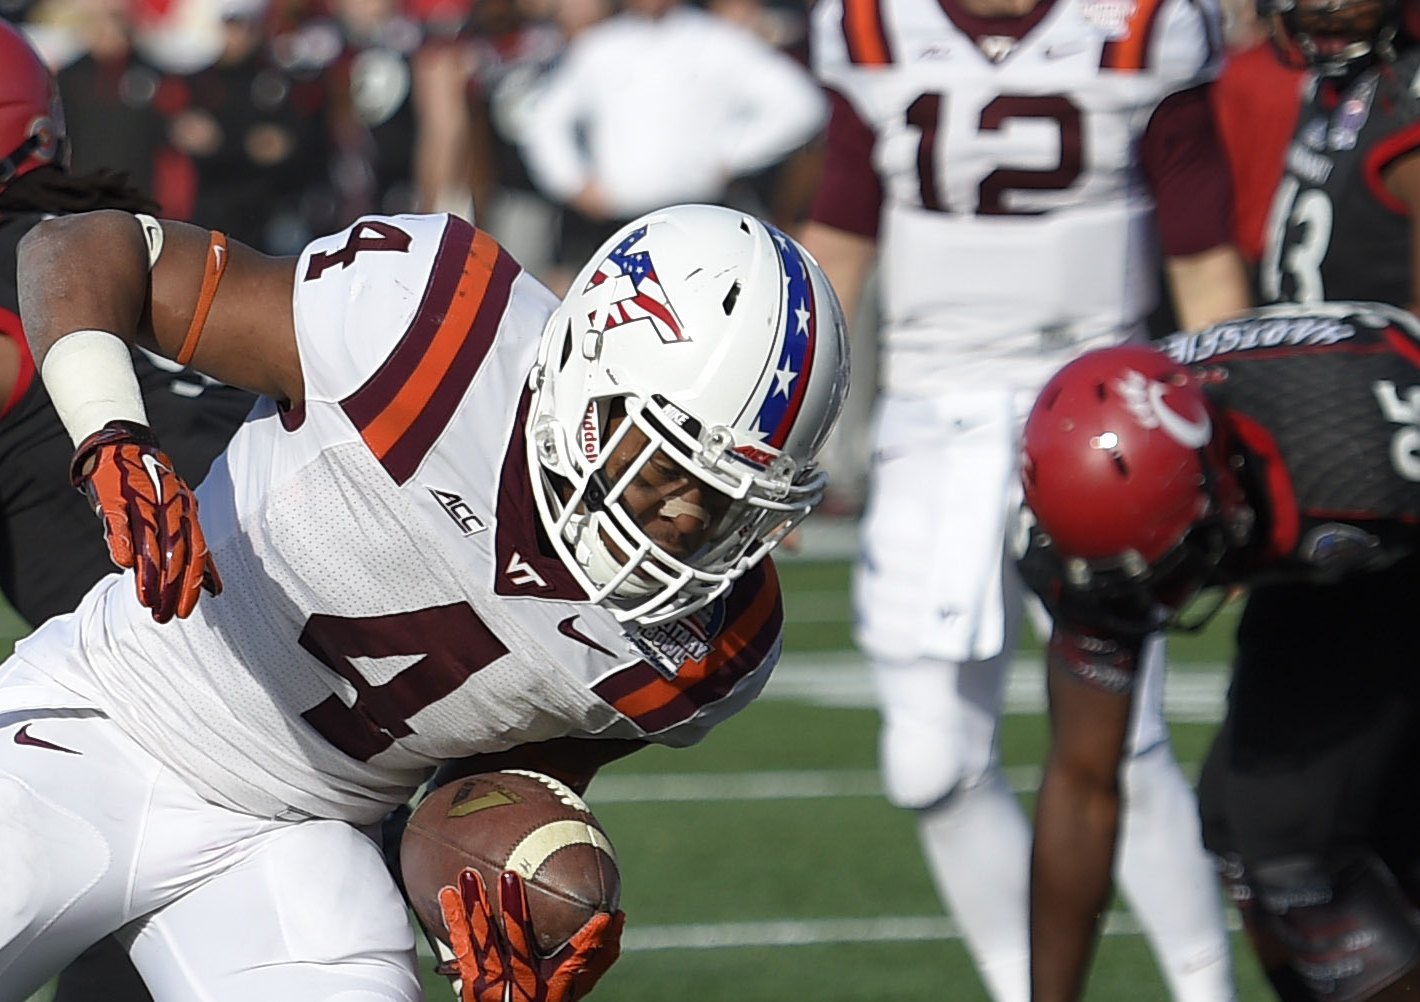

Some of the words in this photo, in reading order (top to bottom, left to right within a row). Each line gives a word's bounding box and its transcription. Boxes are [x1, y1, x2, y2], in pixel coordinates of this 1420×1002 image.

[906, 93, 1084, 216] 12
[304, 220, 412, 283] 4
[662, 401, 690, 427] NIKE
[427, 487, 485, 534] ACC
[505, 551, 548, 587] VT
[298, 601, 510, 762] 4
